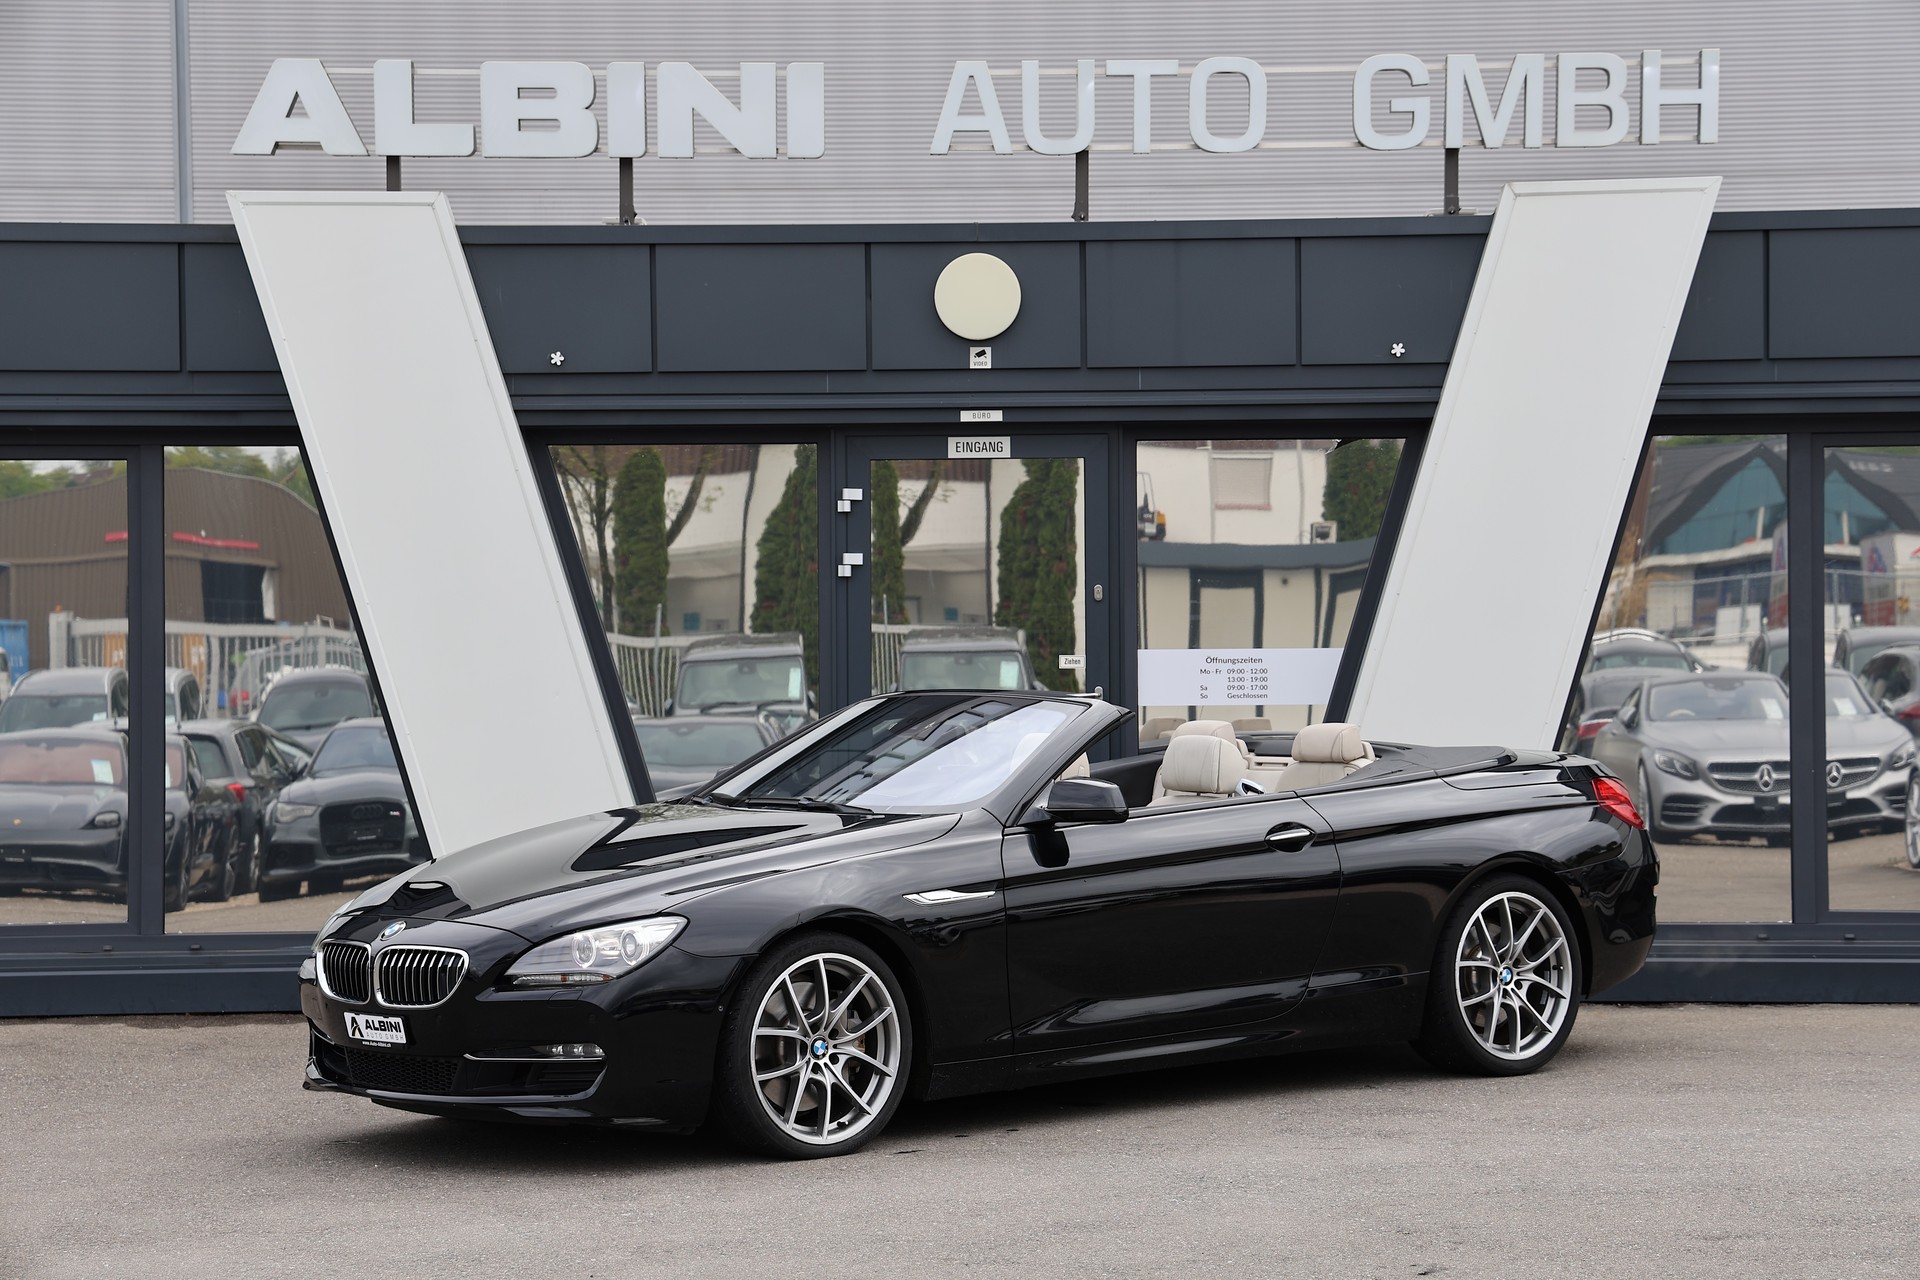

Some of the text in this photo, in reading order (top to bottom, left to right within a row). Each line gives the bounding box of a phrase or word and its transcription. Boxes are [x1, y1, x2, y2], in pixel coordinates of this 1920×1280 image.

[231, 48, 1720, 160] ALBINI AUTO GMBH
[955, 441, 1003, 453] EINGANG
[1205, 656, 1263, 665] Öffnungszeiten
[1199, 684, 1208, 692] Sa
[1199, 692, 1209, 700] So
[365, 1019, 402, 1033] ALBINI
[366, 1031, 404, 1041] AUTO GMBH
